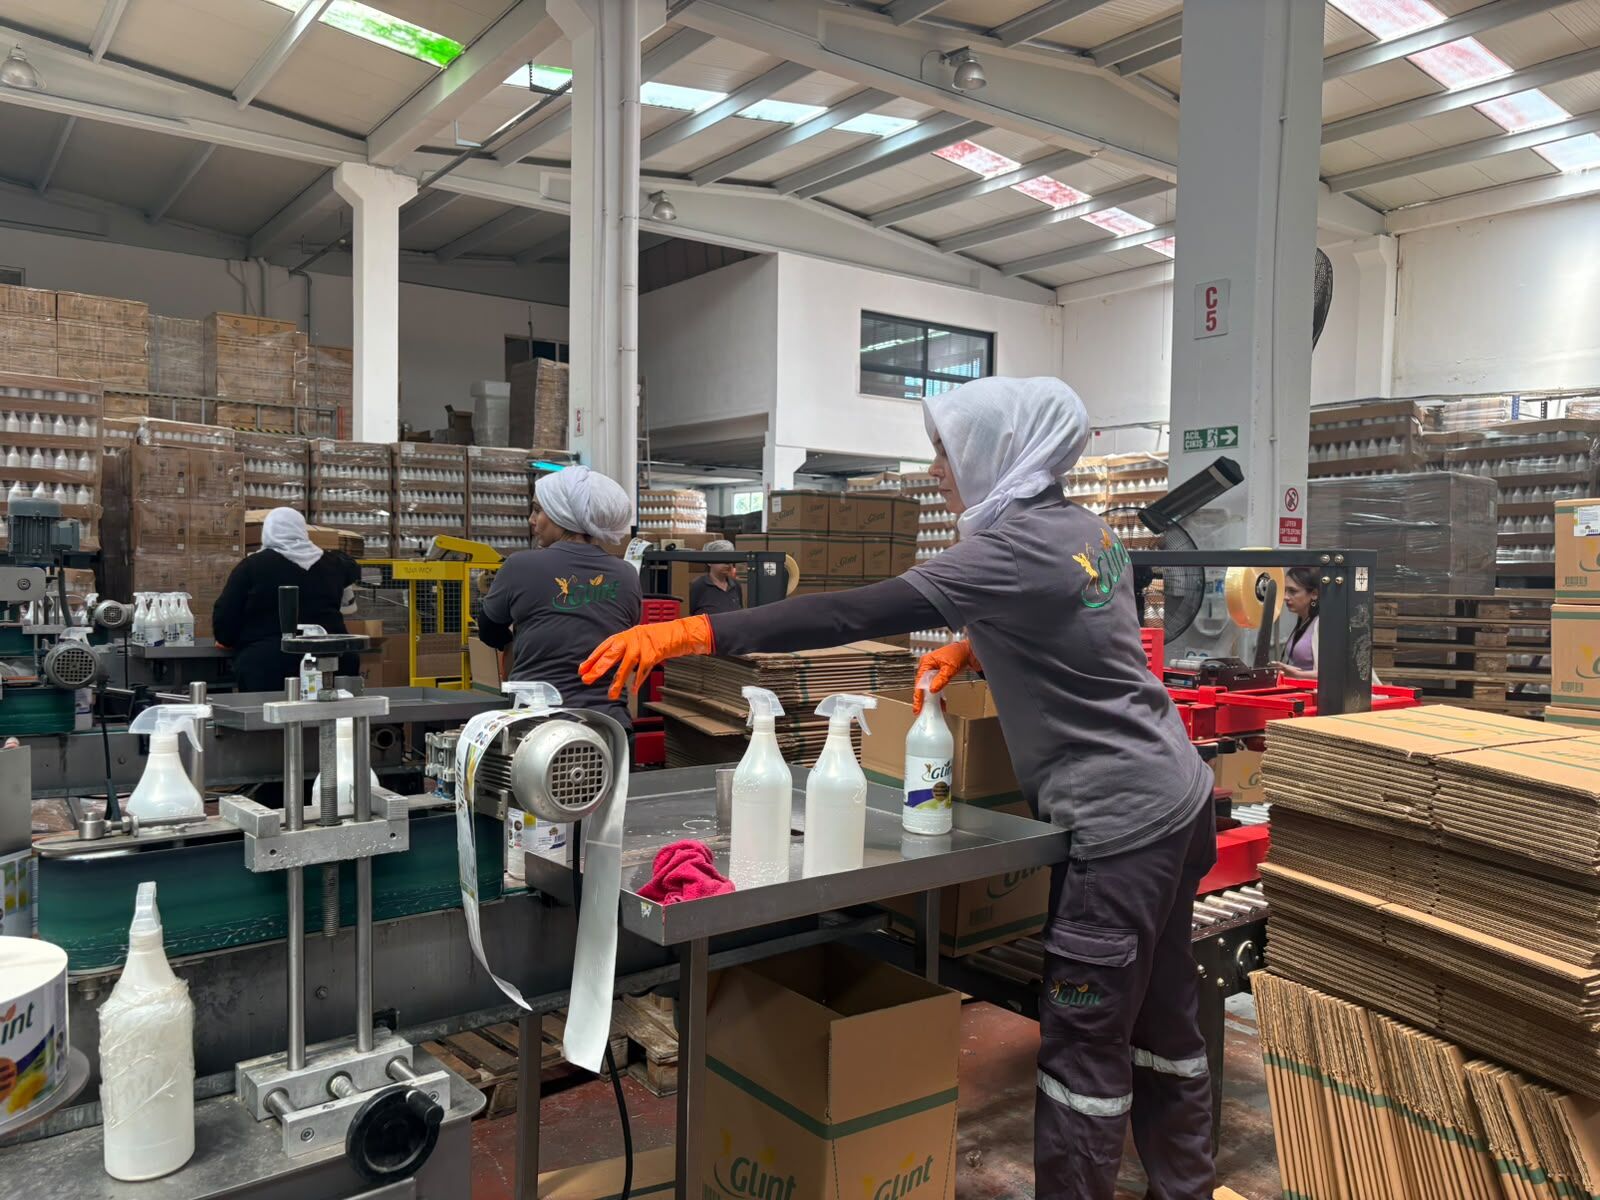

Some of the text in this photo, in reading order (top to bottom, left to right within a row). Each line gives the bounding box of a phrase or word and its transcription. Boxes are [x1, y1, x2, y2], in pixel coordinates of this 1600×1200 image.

[931, 766, 952, 779] Glin
[1, 1002, 34, 1045] int
[730, 1156, 797, 1200] Glint
